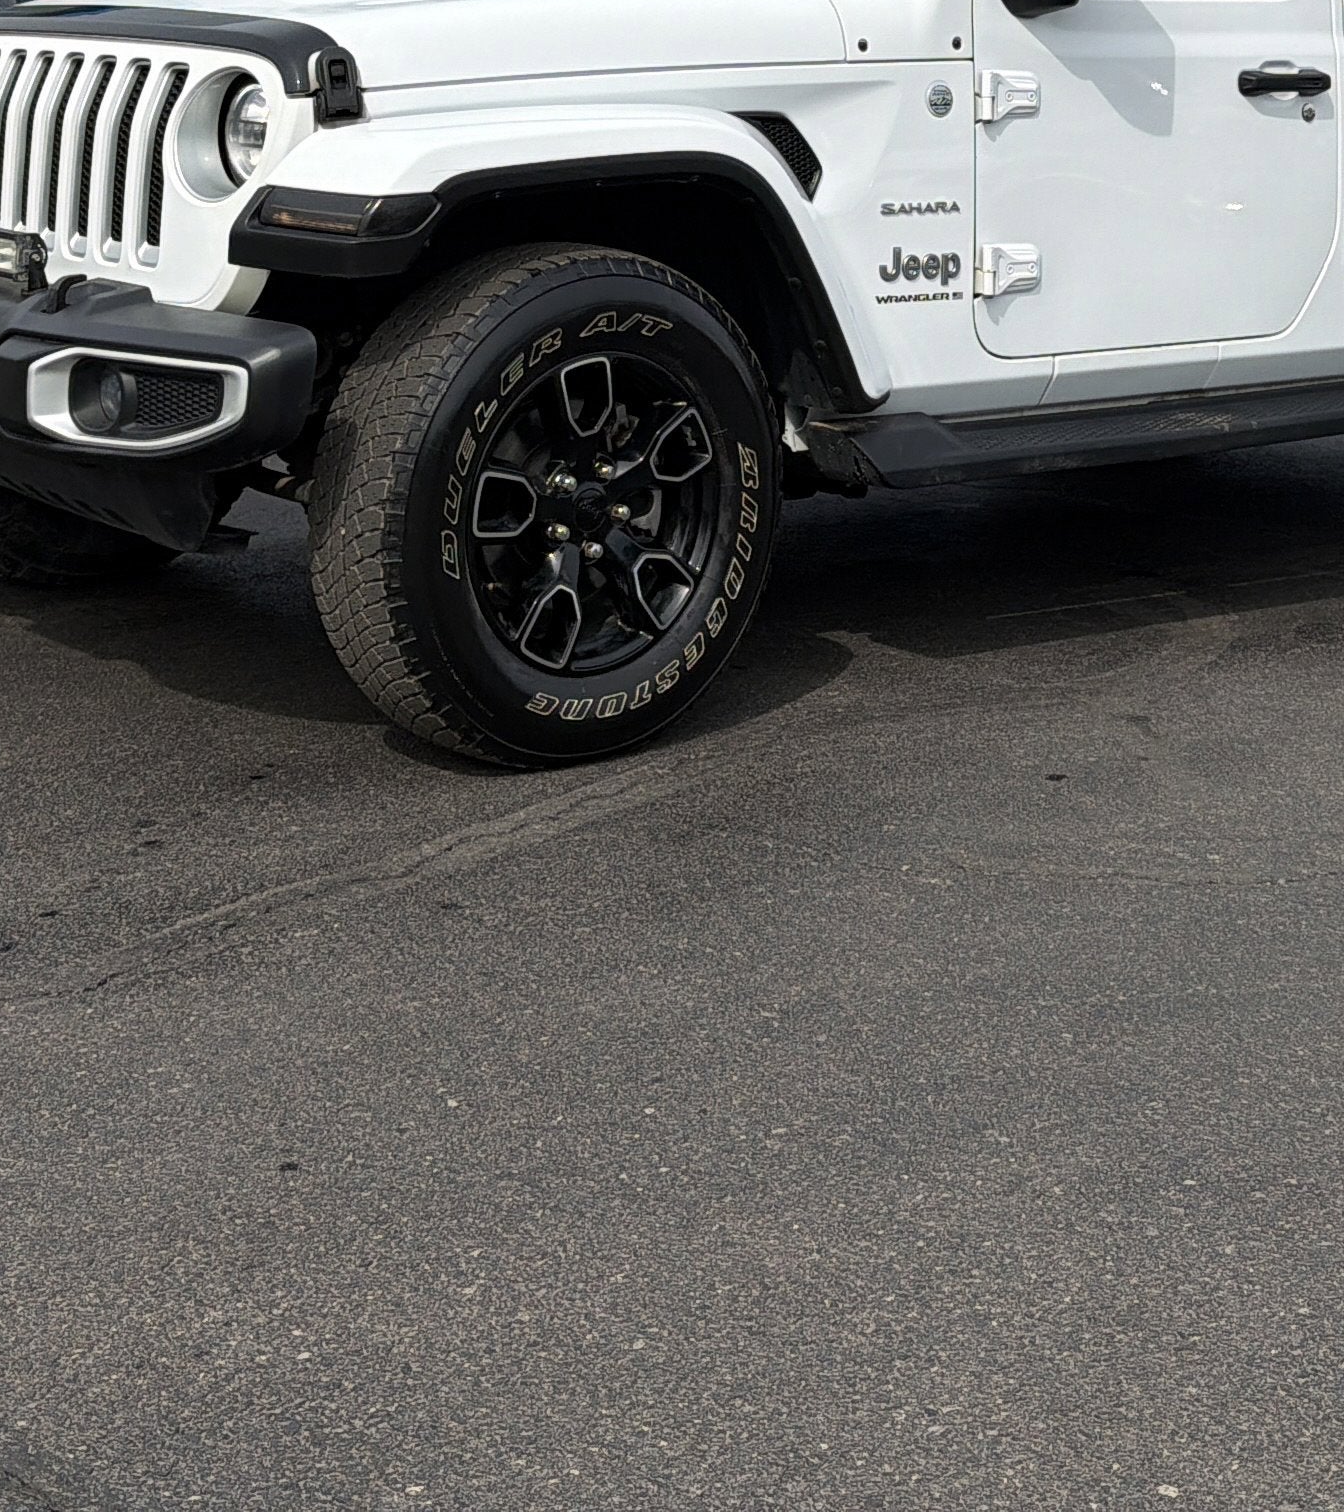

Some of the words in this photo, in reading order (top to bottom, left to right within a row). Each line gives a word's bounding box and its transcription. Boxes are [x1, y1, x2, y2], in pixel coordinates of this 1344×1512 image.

[880, 200, 961, 217] SAHARA
[878, 246, 961, 286] Jeep
[875, 292, 950, 305] WRANGLER
[441, 327, 563, 580] DUELER
[579, 311, 673, 338] A/T
[525, 441, 760, 721] BRIDGESTONE
